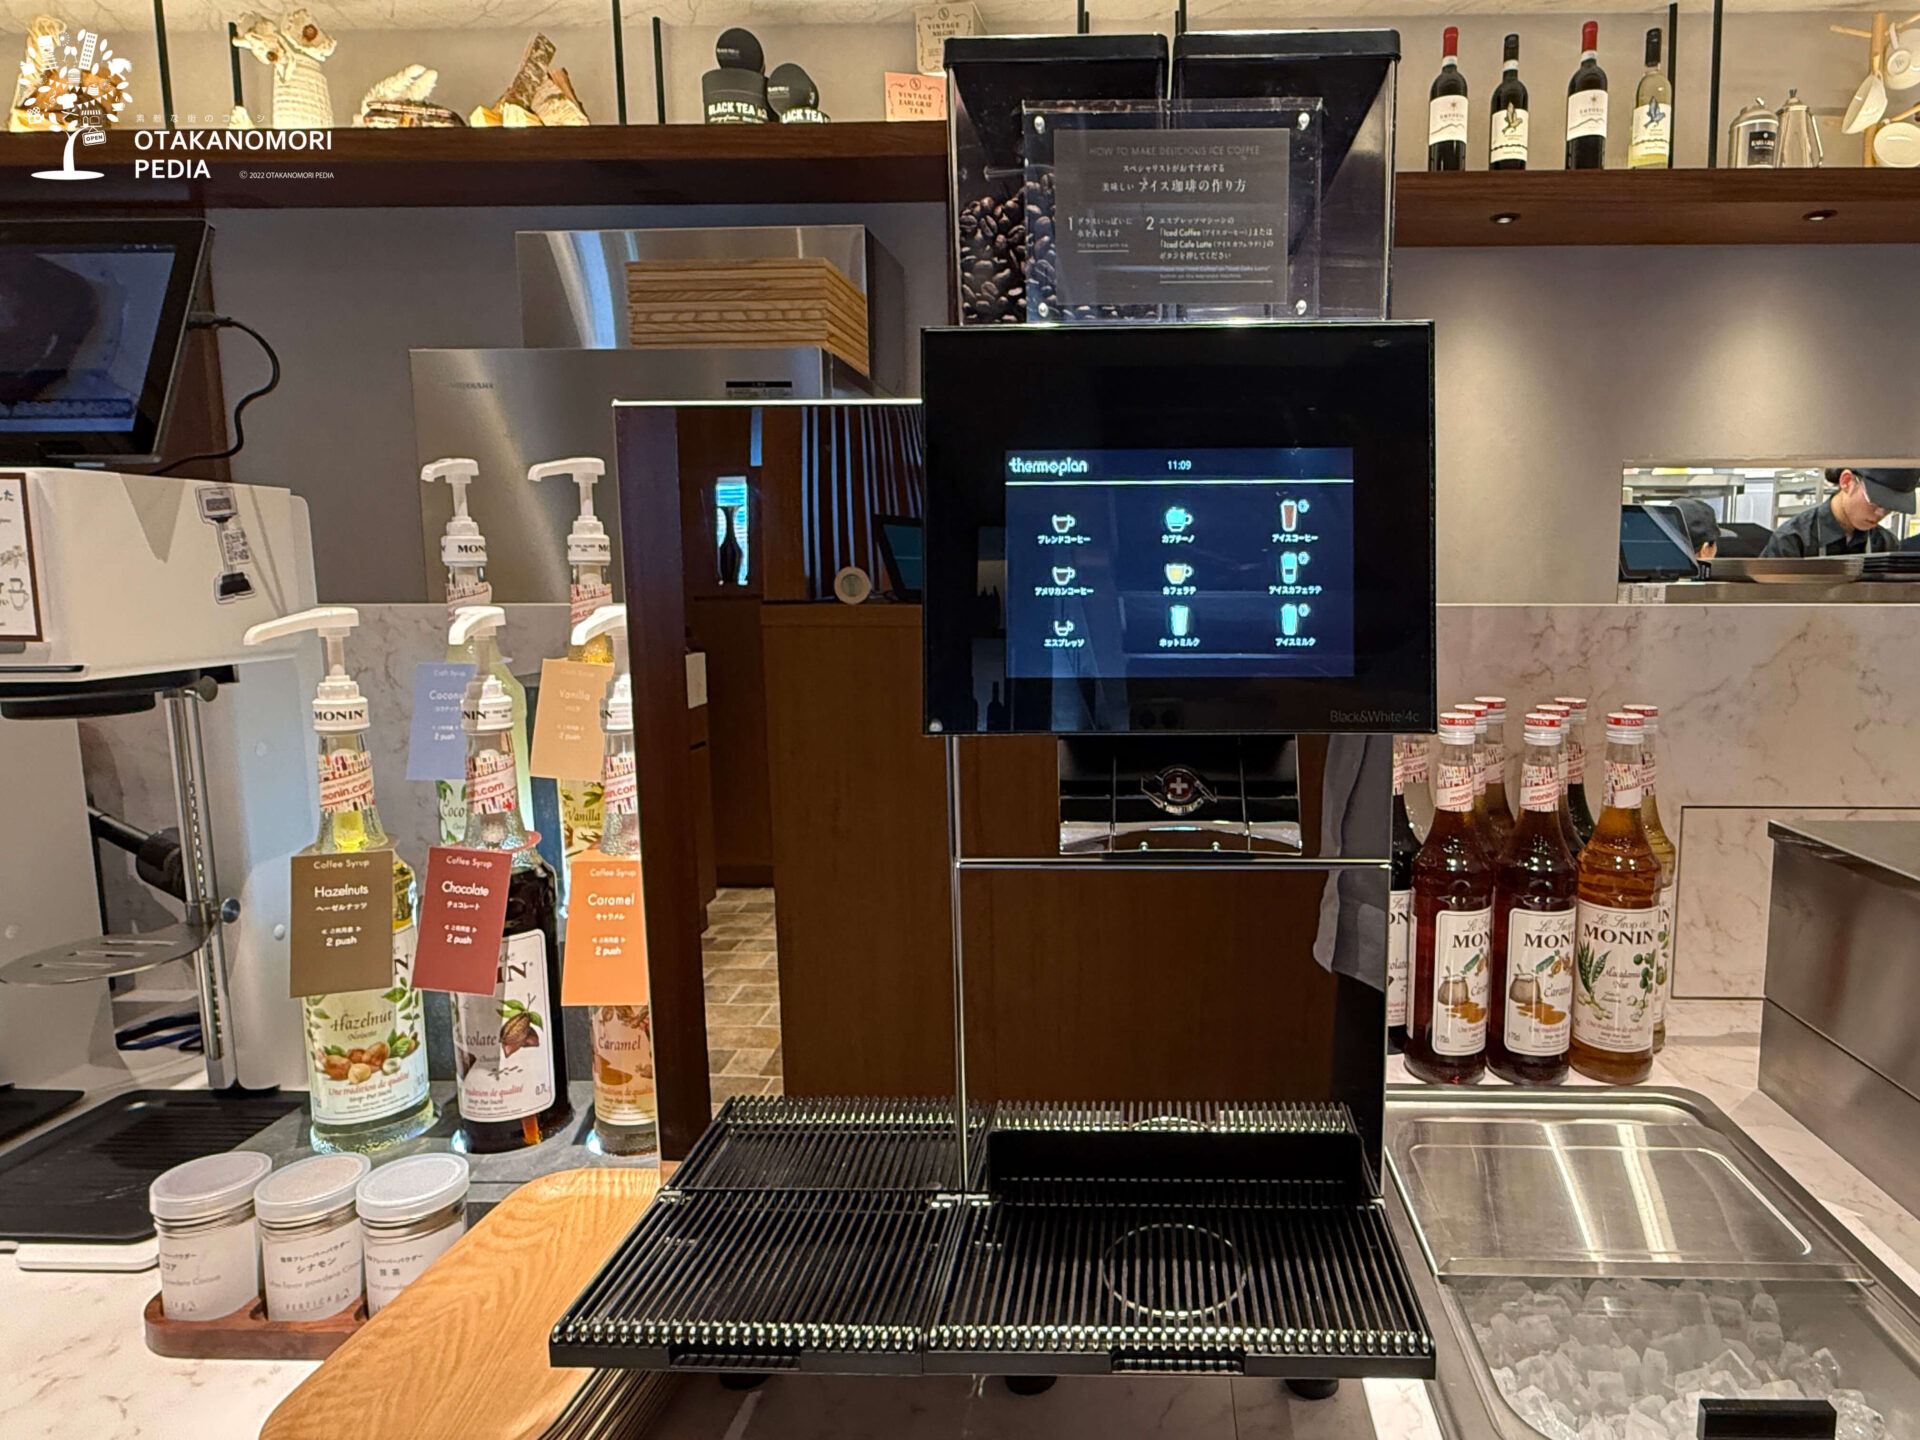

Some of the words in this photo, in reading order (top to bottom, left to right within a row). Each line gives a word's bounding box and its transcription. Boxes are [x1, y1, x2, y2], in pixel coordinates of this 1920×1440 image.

[898, 91, 932, 101] VINTAGE
[708, 102, 734, 116] BLACK
[736, 102, 755, 115] TEA
[909, 107, 924, 115] TEA
[805, 109, 823, 123] TEA
[1089, 147, 1113, 156] HOW
[1115, 147, 1130, 156] TO
[1133, 147, 1157, 156] MAKE
[1159, 146, 1207, 155] DELICIOUS
[1209, 146, 1224, 155] ICE
[1227, 145, 1260, 155] COFFEE
[1068, 217, 1074, 231] 1
[1146, 216, 1155, 231] 2
[1008, 457, 1088, 476] thermoplan
[1167, 460, 1192, 470] 11:09
[1037, 535, 1092, 544] ブレンドコーヒー
[1271, 534, 1319, 543] アイスコーヒー
[1034, 587, 1094, 596] アメリカンコーヒー
[1162, 586, 1197, 595] カフェラテ
[1268, 585, 1322, 595] アイスカフェラテ
[1043, 638, 1085, 648] エスプレッソ
[1159, 637, 1201, 648] ホットミルク
[1275, 637, 1317, 647] アイスミルク
[314, 710, 364, 721] MONIN
[321, 779, 372, 801] monin.com
[313, 860, 343, 869] Coffee
[345, 859, 370, 869] Syrup
[446, 855, 470, 866] Coffee
[472, 858, 493, 869] Syrup
[590, 868, 614, 877] Coffee
[616, 868, 637, 878] Syrup
[314, 883, 369, 898] Hazelnuts
[441, 880, 490, 897] Chocolate
[587, 892, 635, 907] Caramel
[315, 902, 368, 912] ヘーゼルナッツ
[447, 900, 480, 911] チョコレート
[596, 912, 625, 921] キャラメル
[446, 934, 453, 943] 2
[454, 935, 473, 944] push
[1584, 924, 1655, 945] MONIN
[326, 937, 333, 947] 2
[335, 936, 357, 947] push
[595, 946, 602, 956] 2
[603, 946, 622, 957] push
[330, 1010, 392, 1032] Hazelnut
[598, 1034, 641, 1051] Caramel
[297, 1257, 337, 1274] シナモン
